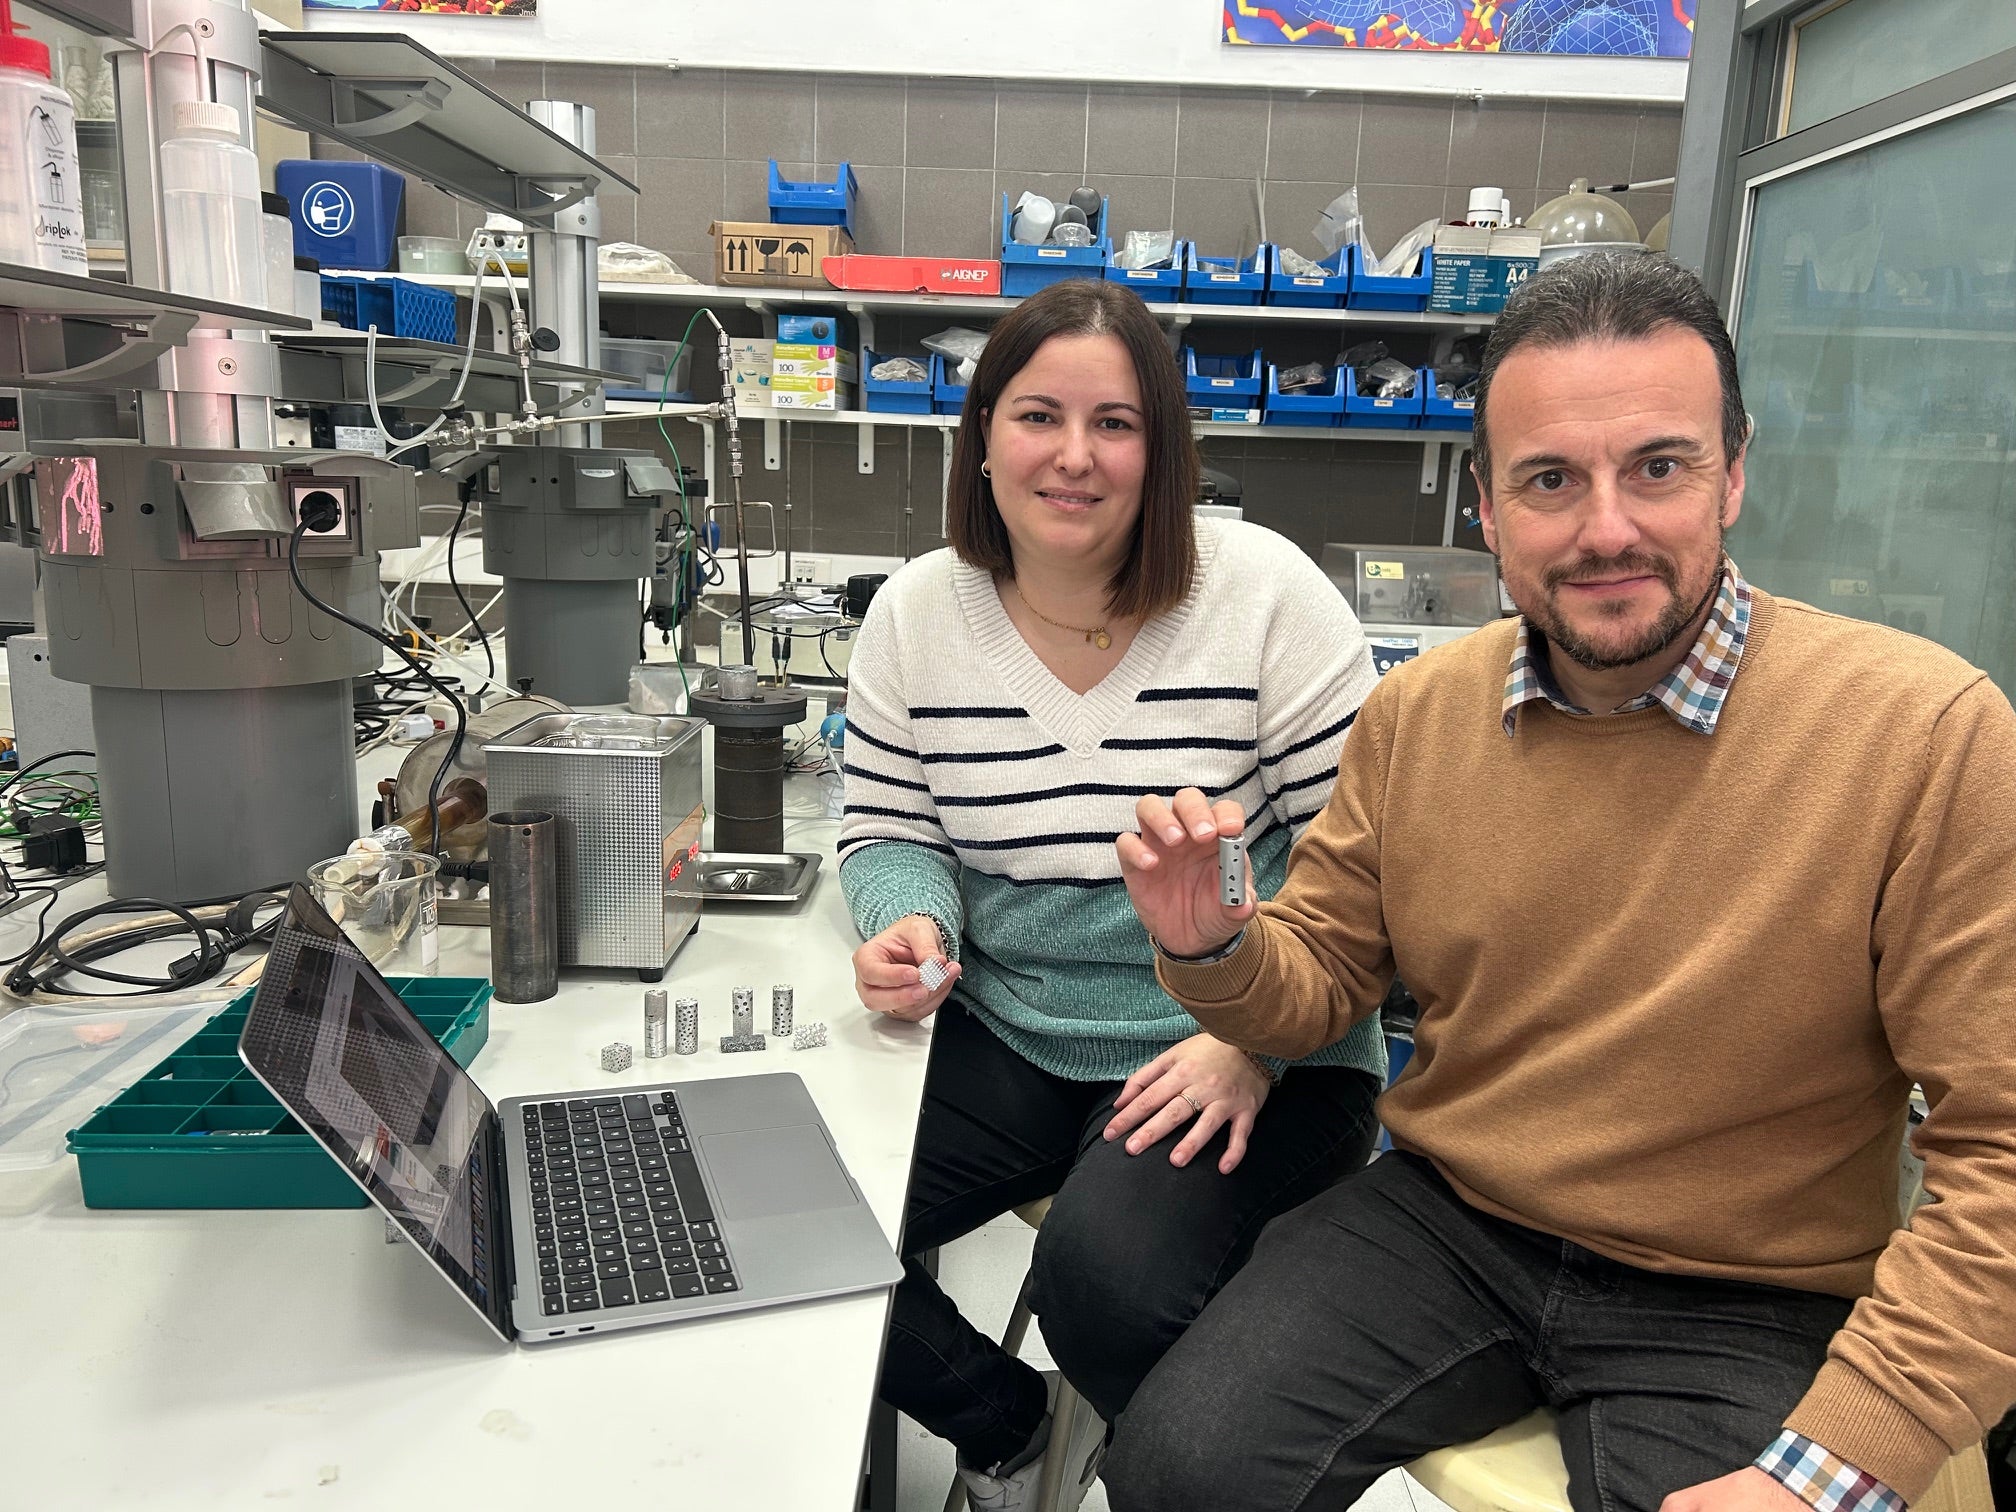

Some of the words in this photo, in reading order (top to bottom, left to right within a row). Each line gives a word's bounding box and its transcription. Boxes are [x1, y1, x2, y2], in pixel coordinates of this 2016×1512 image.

[952, 268, 989, 281] AIGNEP
[1505, 267, 1529, 283] A4
[822, 347, 831, 355] M
[779, 364, 794, 372] 100
[777, 396, 793, 404] 100
